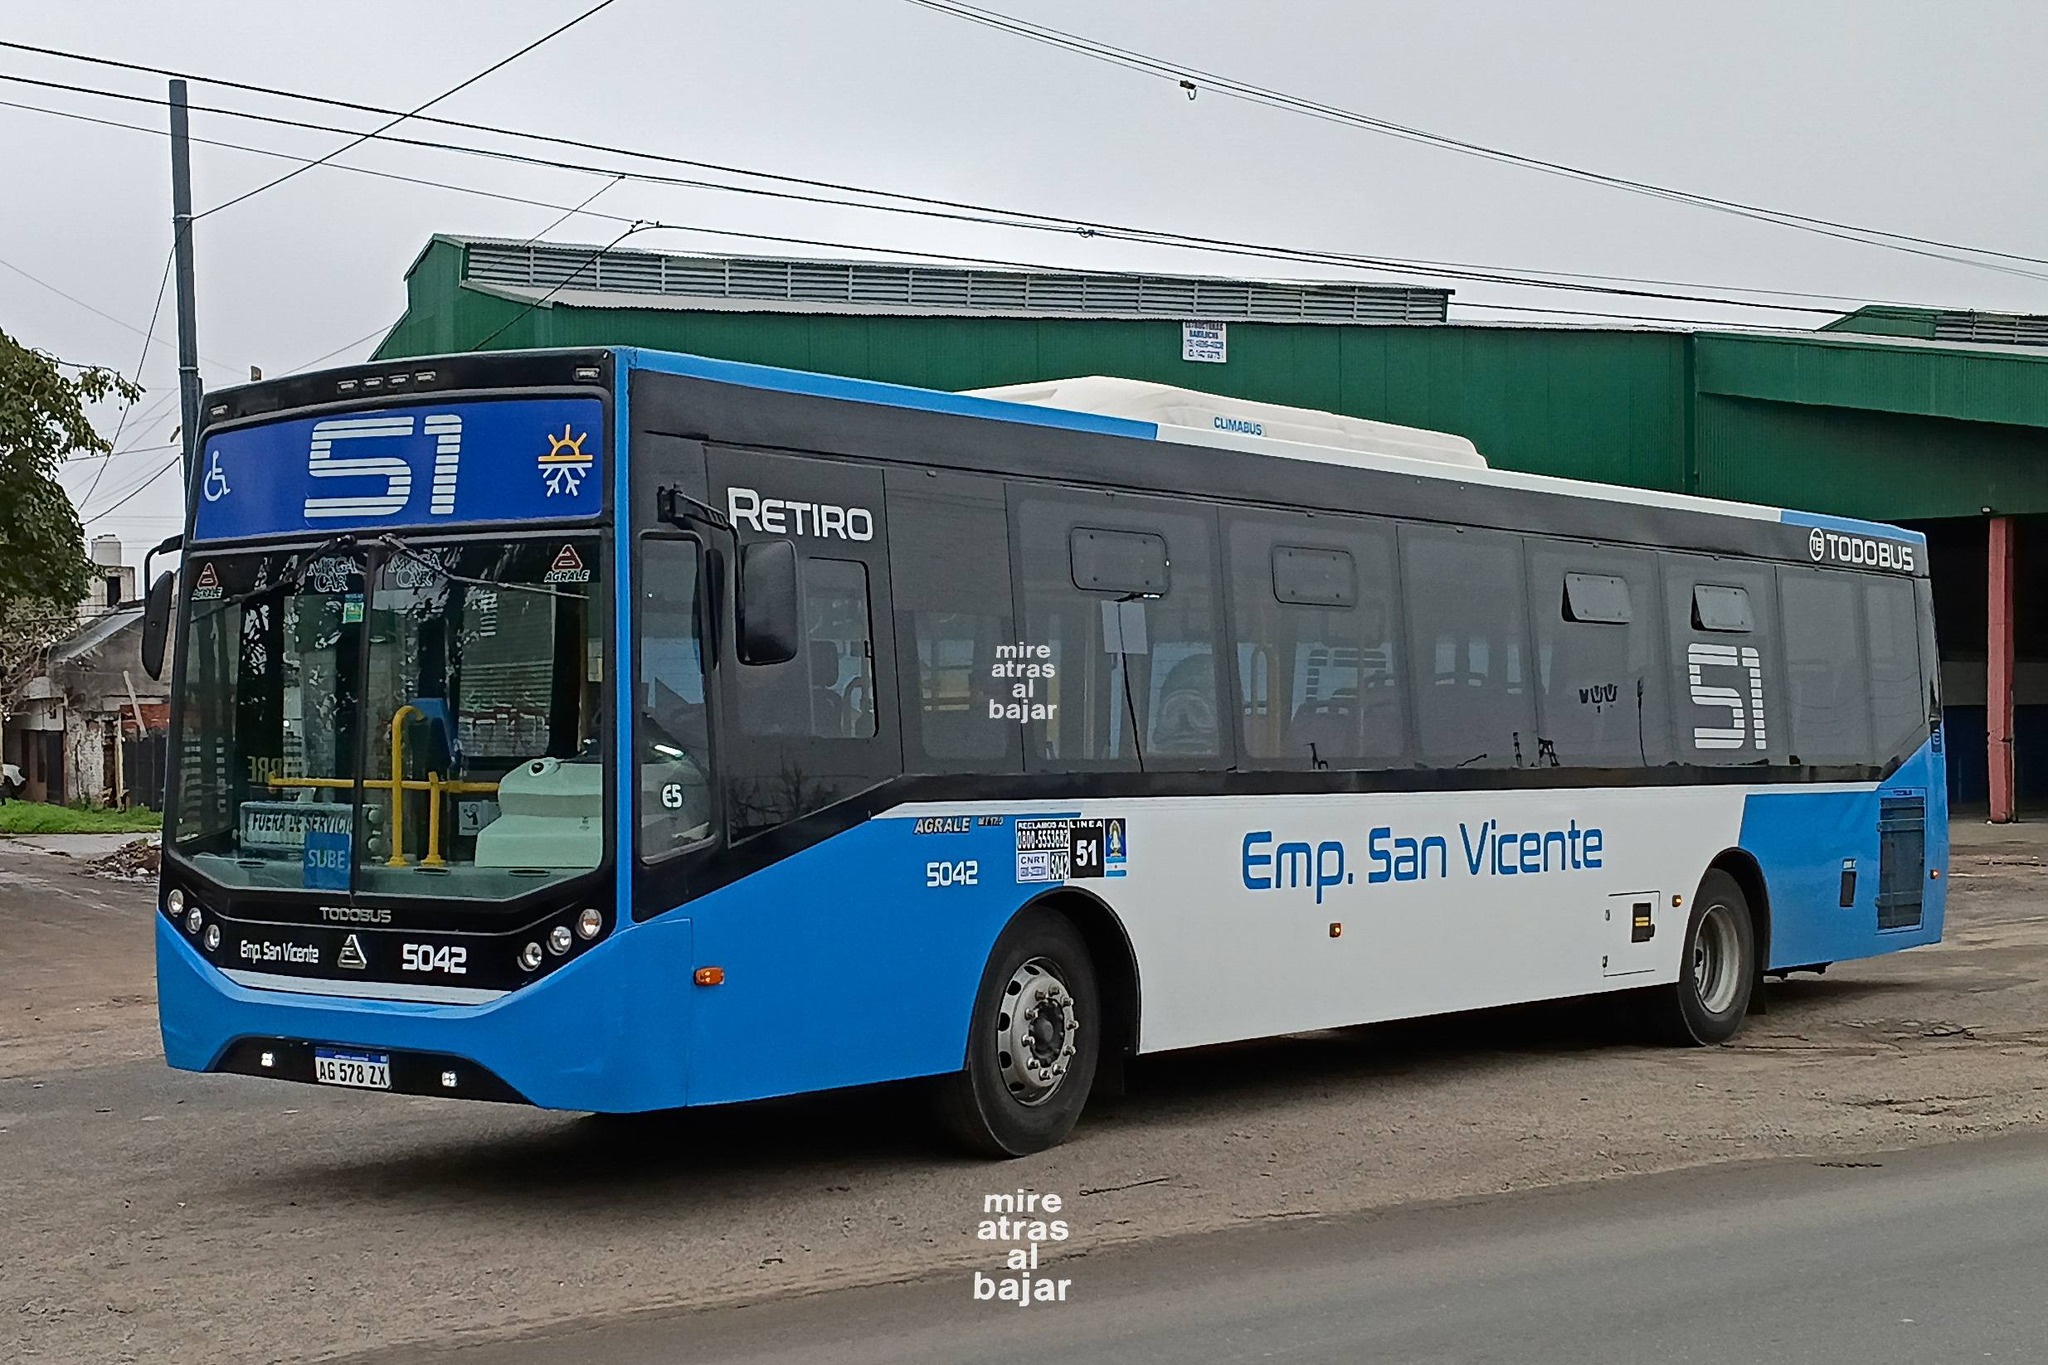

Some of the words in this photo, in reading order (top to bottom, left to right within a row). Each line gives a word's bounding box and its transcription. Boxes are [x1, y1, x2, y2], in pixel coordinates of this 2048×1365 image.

[1213, 416, 1262, 435] CLIMABUS
[303, 414, 463, 518] 51
[1826, 533, 1914, 571] TODOBUS
[543, 570, 591, 583] AGRALE
[1688, 643, 1766, 750] 51
[914, 817, 971, 834] AGRALE
[1058, 821, 1068, 829] AL
[1070, 820, 1103, 829] LINEA
[308, 849, 346, 869] SUBE
[1020, 856, 1045, 865] CNRT
[1075, 839, 1098, 867] 51
[1242, 831, 1354, 905] Emp.
[1368, 827, 1447, 884] San
[1459, 819, 1603, 876] Vicente
[926, 860, 978, 887] 5042
[319, 906, 392, 924] TODOBUS
[263, 941, 282, 961] San
[282, 941, 319, 964] Vicente
[401, 943, 467, 974] 5042
[319, 1061, 336, 1081] AG
[339, 1062, 365, 1084] 578
[368, 1065, 387, 1086] ZX
